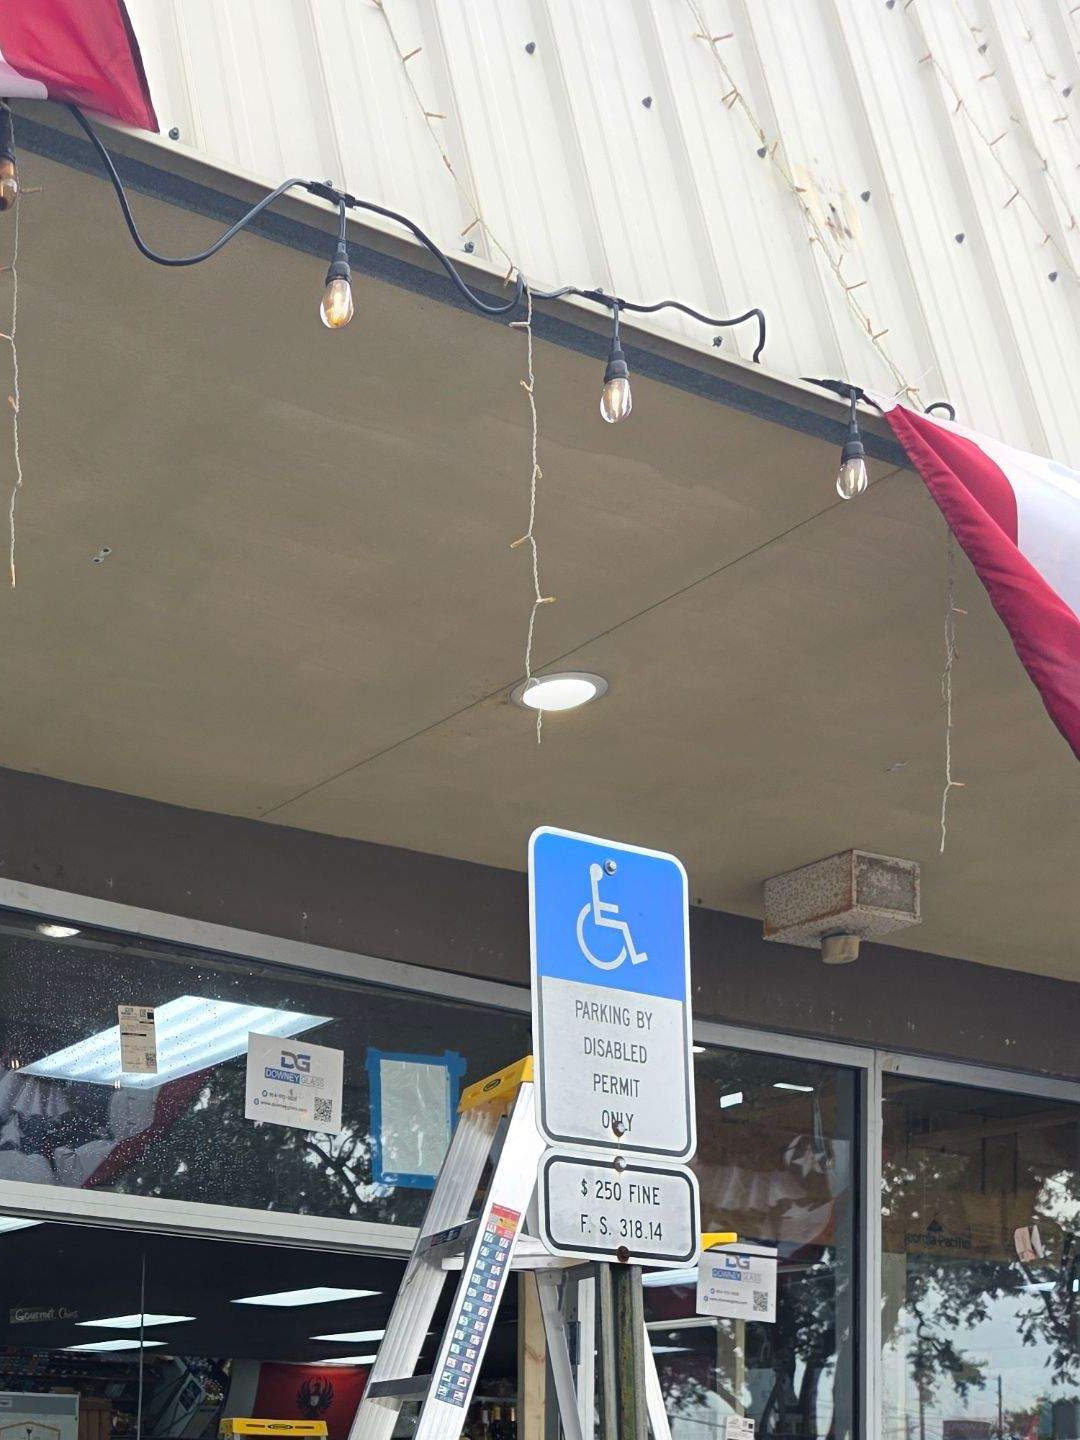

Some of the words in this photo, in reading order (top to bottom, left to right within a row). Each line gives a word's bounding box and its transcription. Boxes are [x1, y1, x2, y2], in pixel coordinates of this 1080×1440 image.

[575, 1000, 631, 1028] PARKING
[636, 1012, 653, 1031] BY
[281, 1050, 311, 1073] DG
[584, 1036, 647, 1065] DISABLED
[265, 1068, 300, 1084] DOWNEY
[593, 1073, 640, 1099] PERMIT
[580, 1179, 588, 1198] $
[595, 1179, 622, 1202] 250
[629, 1184, 661, 1206] FINE
[580, 1214, 590, 1234] F.
[600, 1216, 612, 1236] S.
[620, 1218, 663, 1241] 318.14
